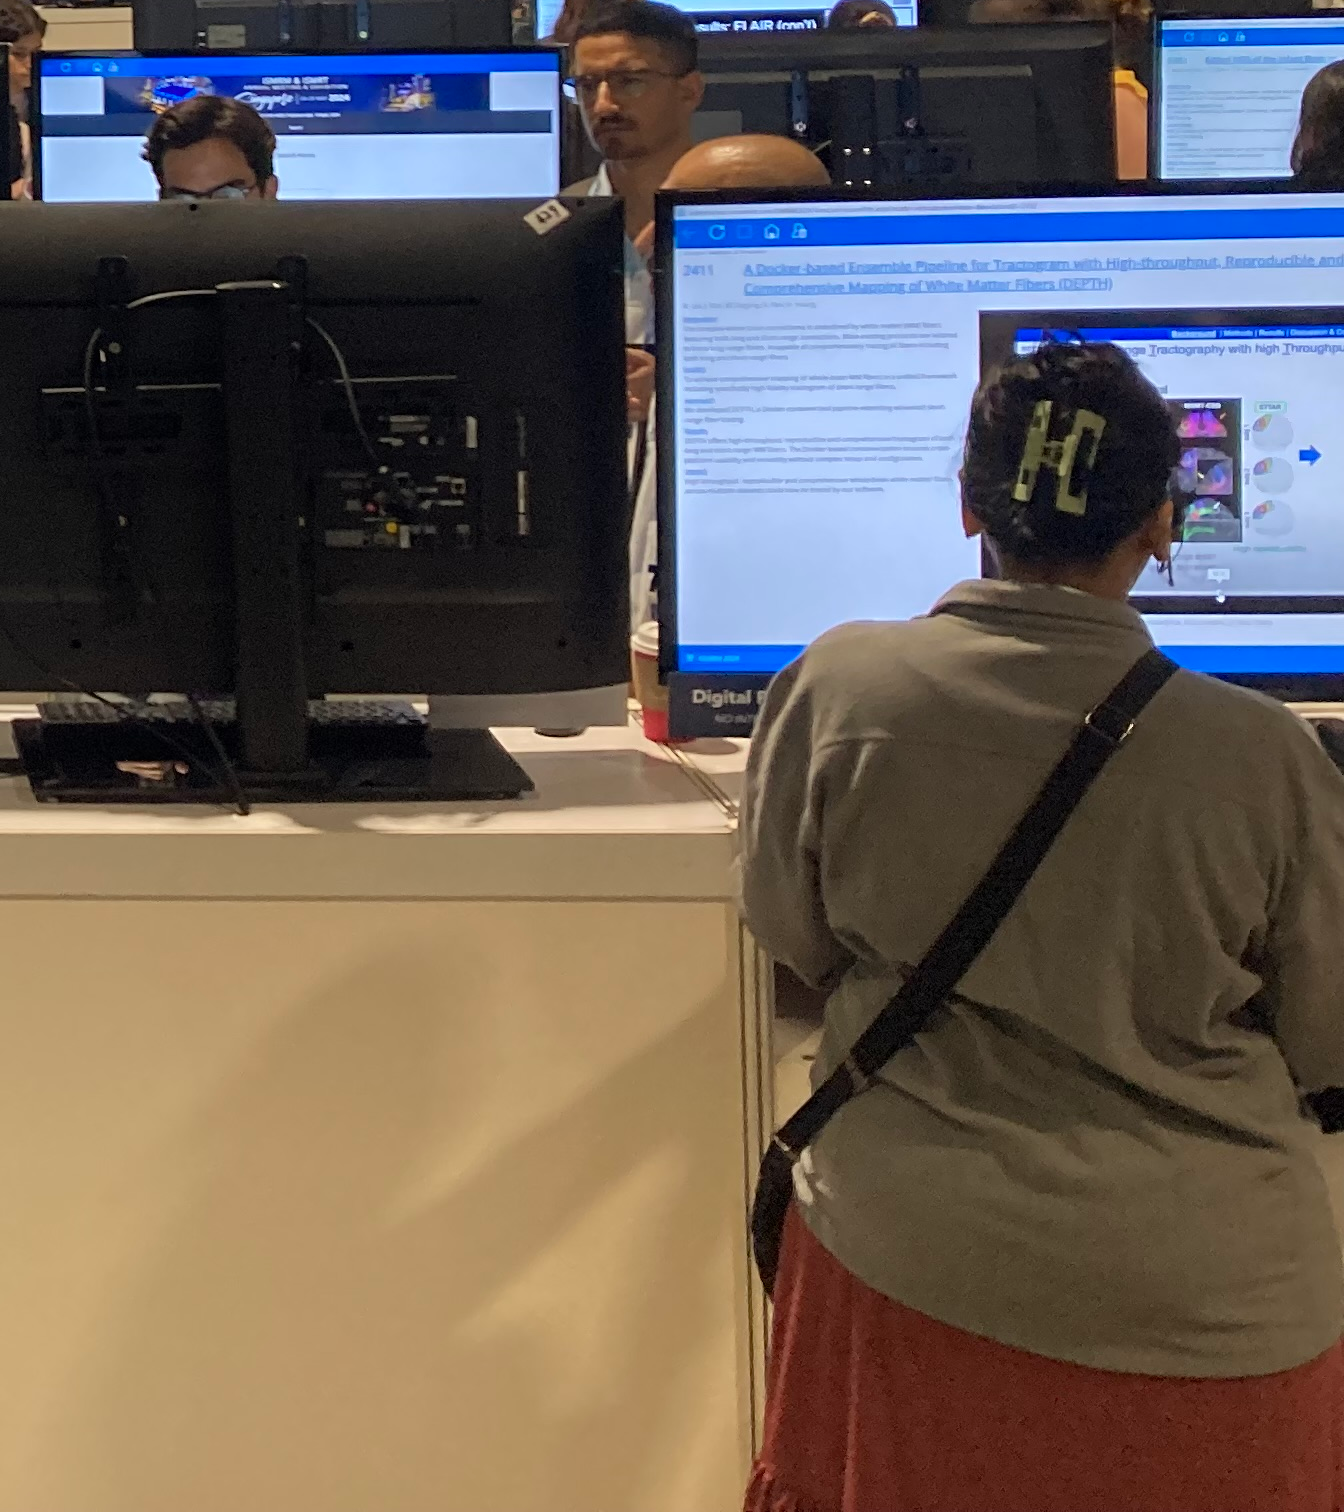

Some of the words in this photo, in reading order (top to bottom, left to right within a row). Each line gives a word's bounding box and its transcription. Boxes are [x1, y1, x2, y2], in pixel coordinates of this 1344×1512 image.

[848, 261, 911, 273] Ensemble
[916, 260, 968, 274] Pipeline
[971, 259, 990, 271] for
[993, 259, 1069, 274] Tractogram
[1074, 257, 1101, 270] with
[1226, 255, 1315, 268] Reproducible
[1318, 254, 1343, 267] and
[909, 280, 923, 292] of
[925, 280, 963, 292] White
[968, 280, 1012, 292] Matter
[1016, 278, 1055, 291] Fibers
[1059, 277, 1113, 291] (DEPTH)
[1149, 344, 1225, 357] Tractography
[1228, 344, 1251, 353] with
[1255, 343, 1279, 355] high
[1282, 343, 1344, 356] Throughpu
[692, 689, 752, 708] Digital
